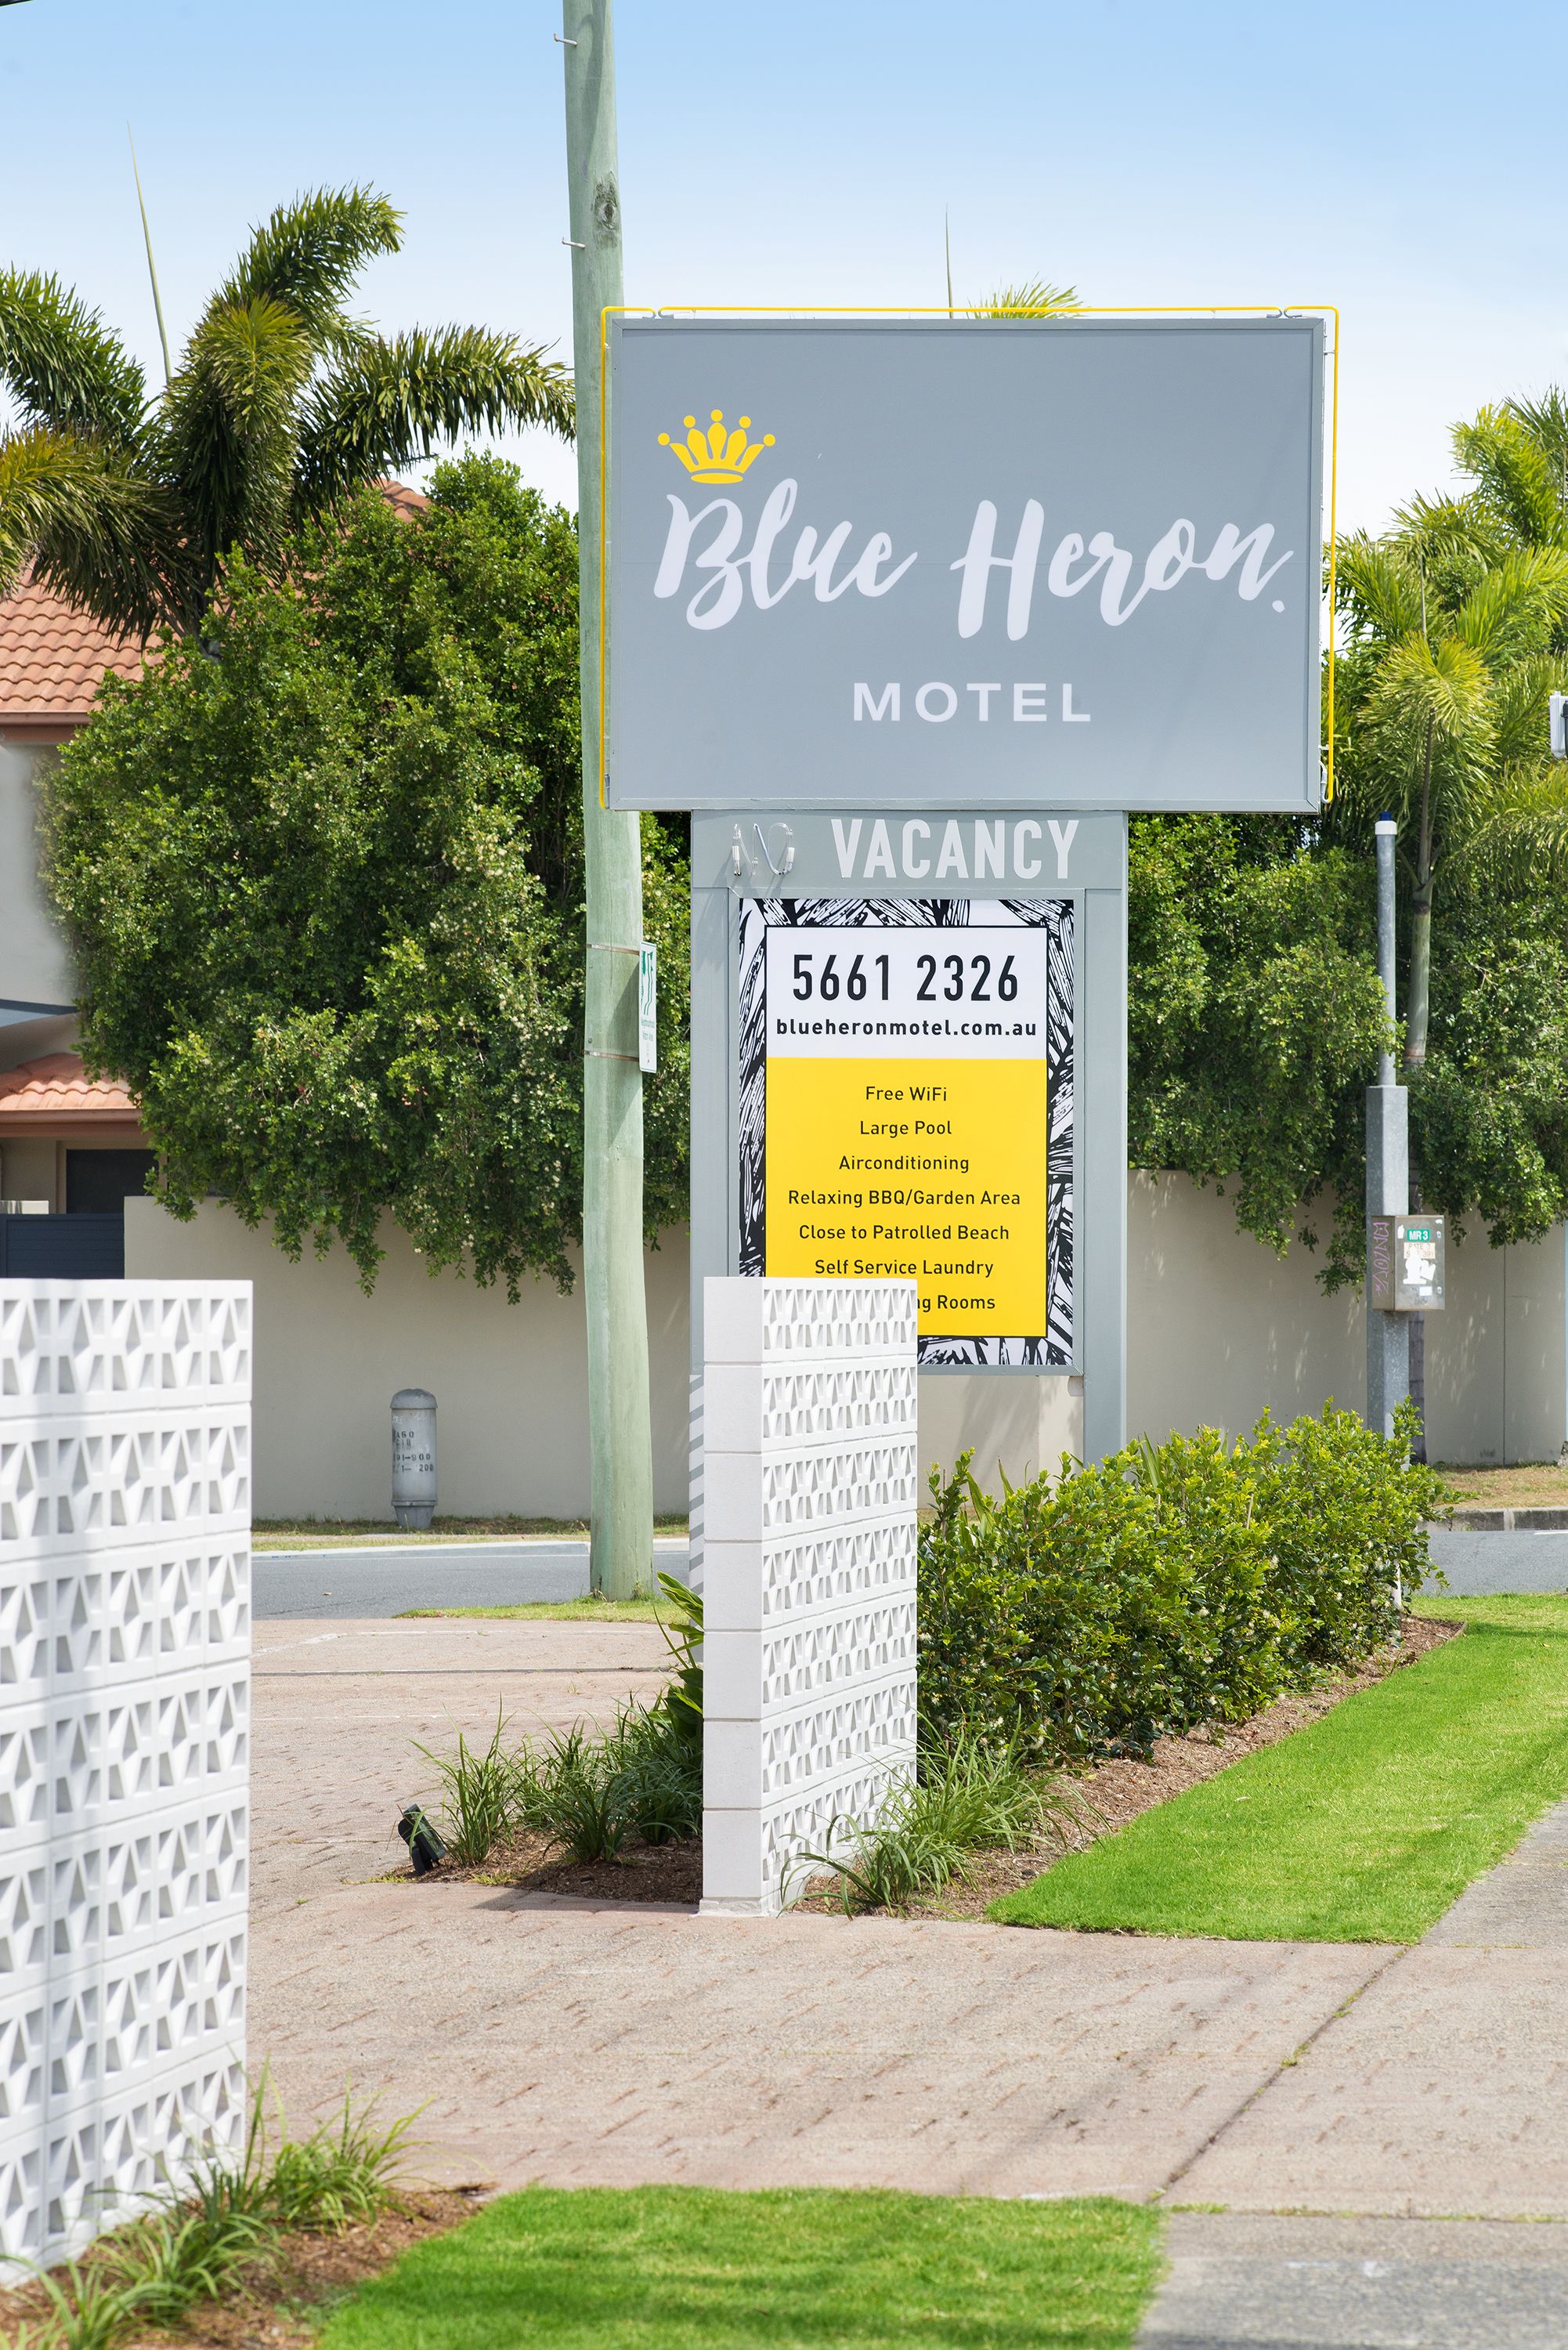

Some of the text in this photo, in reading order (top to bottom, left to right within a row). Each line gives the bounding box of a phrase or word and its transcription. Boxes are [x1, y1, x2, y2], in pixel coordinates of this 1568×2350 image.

[653, 478, 918, 631] Blue
[853, 682, 1091, 723] MOTEL
[830, 819, 1079, 880] VACANCY
[793, 954, 1018, 1002] 5661 2326
[776, 1018, 1037, 1036] blueheronmotel.com.au
[865, 1086, 947, 1101] Free WiFi
[860, 1120, 952, 1139] Large Pool
[838, 1155, 970, 1174] Airconditioning
[788, 1188, 1021, 1209] Relaxing BBQ/Garden Area
[798, 1224, 1010, 1240] Close to Patrolled Beach
[1409, 1230, 1429, 1241] MR 3
[815, 1259, 994, 1279] Self Service Laundry
[937, 1294, 996, 1311] Rooms
